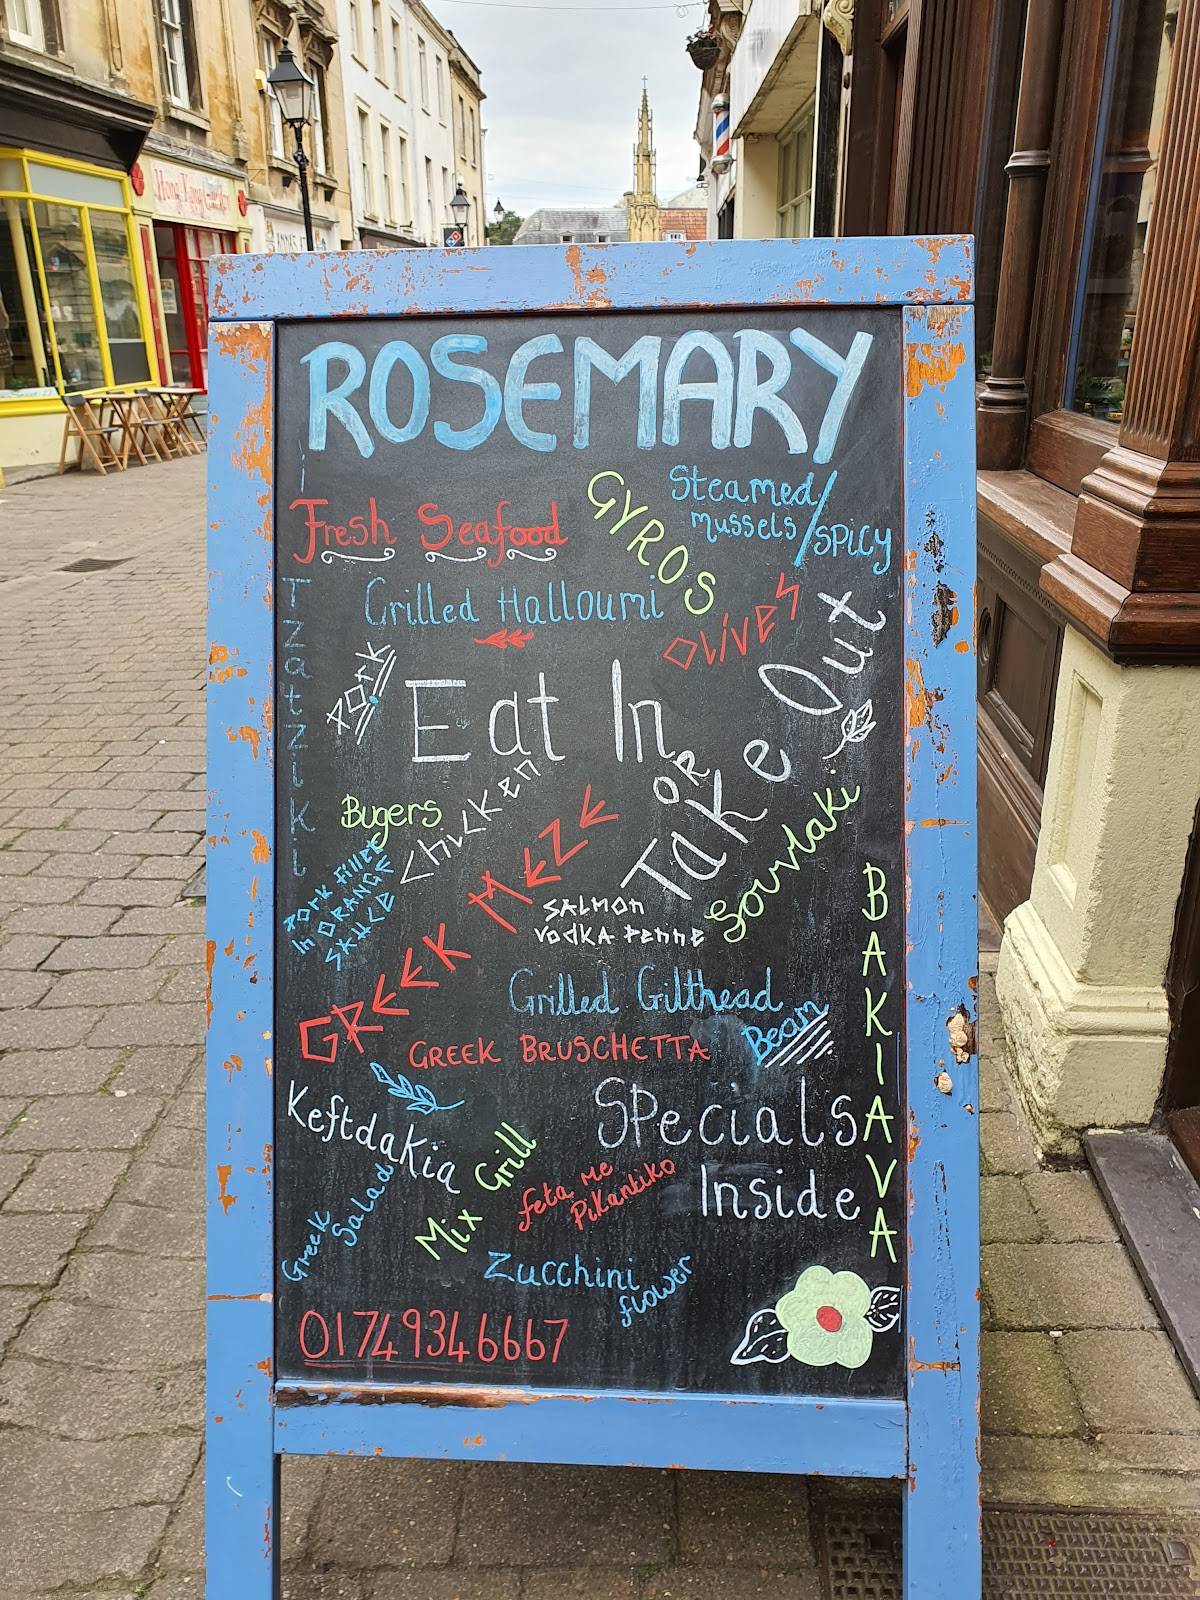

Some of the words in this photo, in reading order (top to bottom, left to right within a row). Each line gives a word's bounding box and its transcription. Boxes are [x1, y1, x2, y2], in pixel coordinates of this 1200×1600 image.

[300, 327, 874, 464] ROSEMARY
[669, 464, 820, 508] Steamed
[289, 496, 397, 564] Fresh
[417, 499, 569, 568] Seafood
[587, 470, 716, 615] GYROS
[690, 509, 797, 544] mussels
[364, 575, 480, 626] Grilled
[497, 574, 665, 626] Halloumi
[757, 591, 887, 716] Out
[404, 672, 566, 763] Eat
[610, 658, 676, 763] In
[340, 794, 443, 850] Bugers
[703, 768, 861, 944] Souvlaki
[508, 967, 620, 1017] Grilled
[636, 964, 785, 1016] Gilthead
[408, 1036, 501, 1070] GREEK
[518, 1030, 711, 1064] BRUSCHETTA
[413, 1208, 484, 1261] Mix
[474, 1121, 538, 1191] Grill
[700, 1161, 861, 1222] Inside
[482, 1249, 643, 1293] Zucchini
